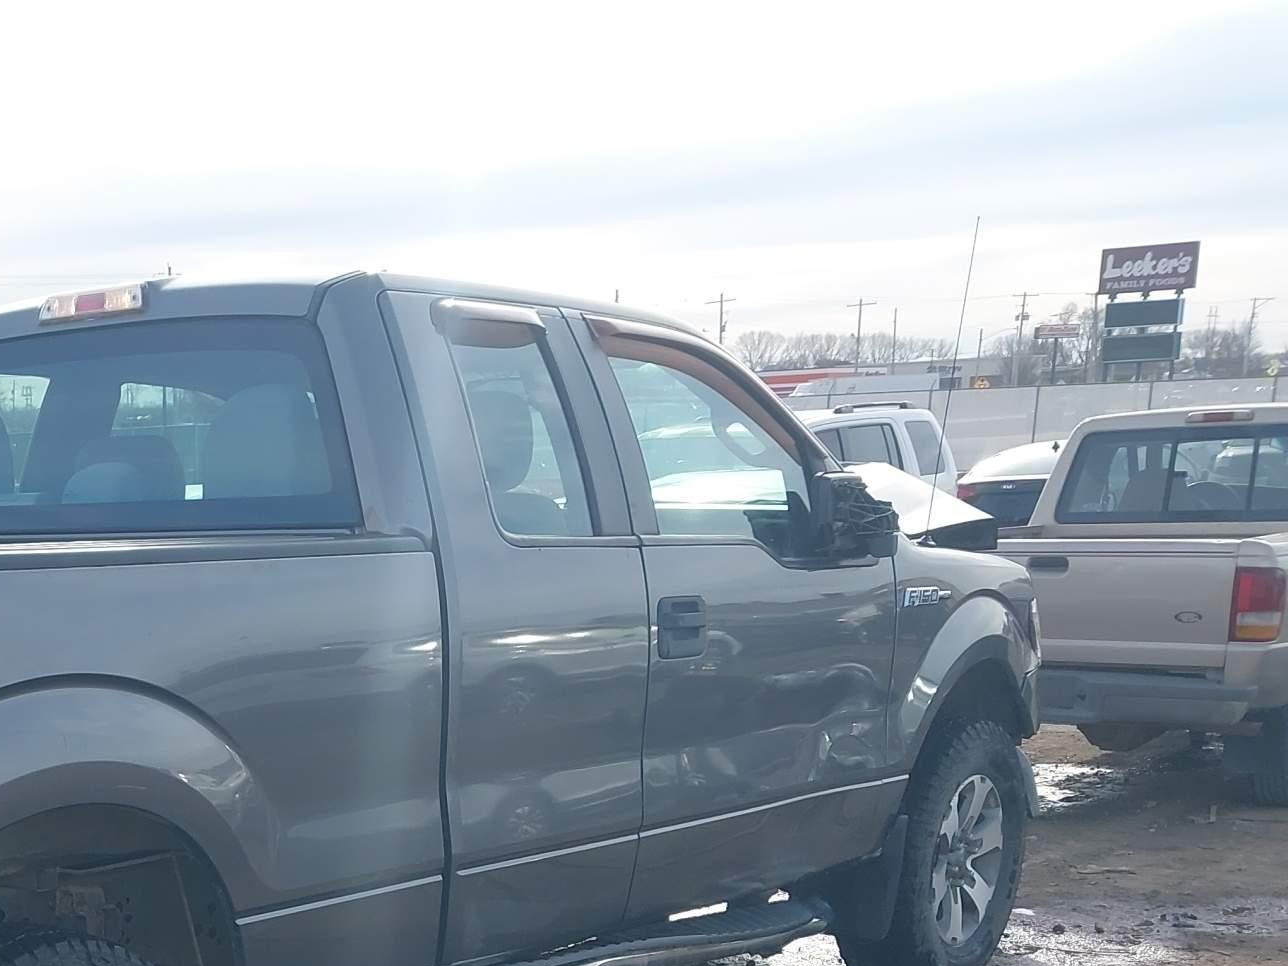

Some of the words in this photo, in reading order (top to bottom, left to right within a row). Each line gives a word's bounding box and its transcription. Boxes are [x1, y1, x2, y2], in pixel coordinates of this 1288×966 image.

[1103, 251, 1193, 279] Leeker's
[1105, 279, 1146, 290] FAMILY
[1148, 277, 1186, 287] FOODS
